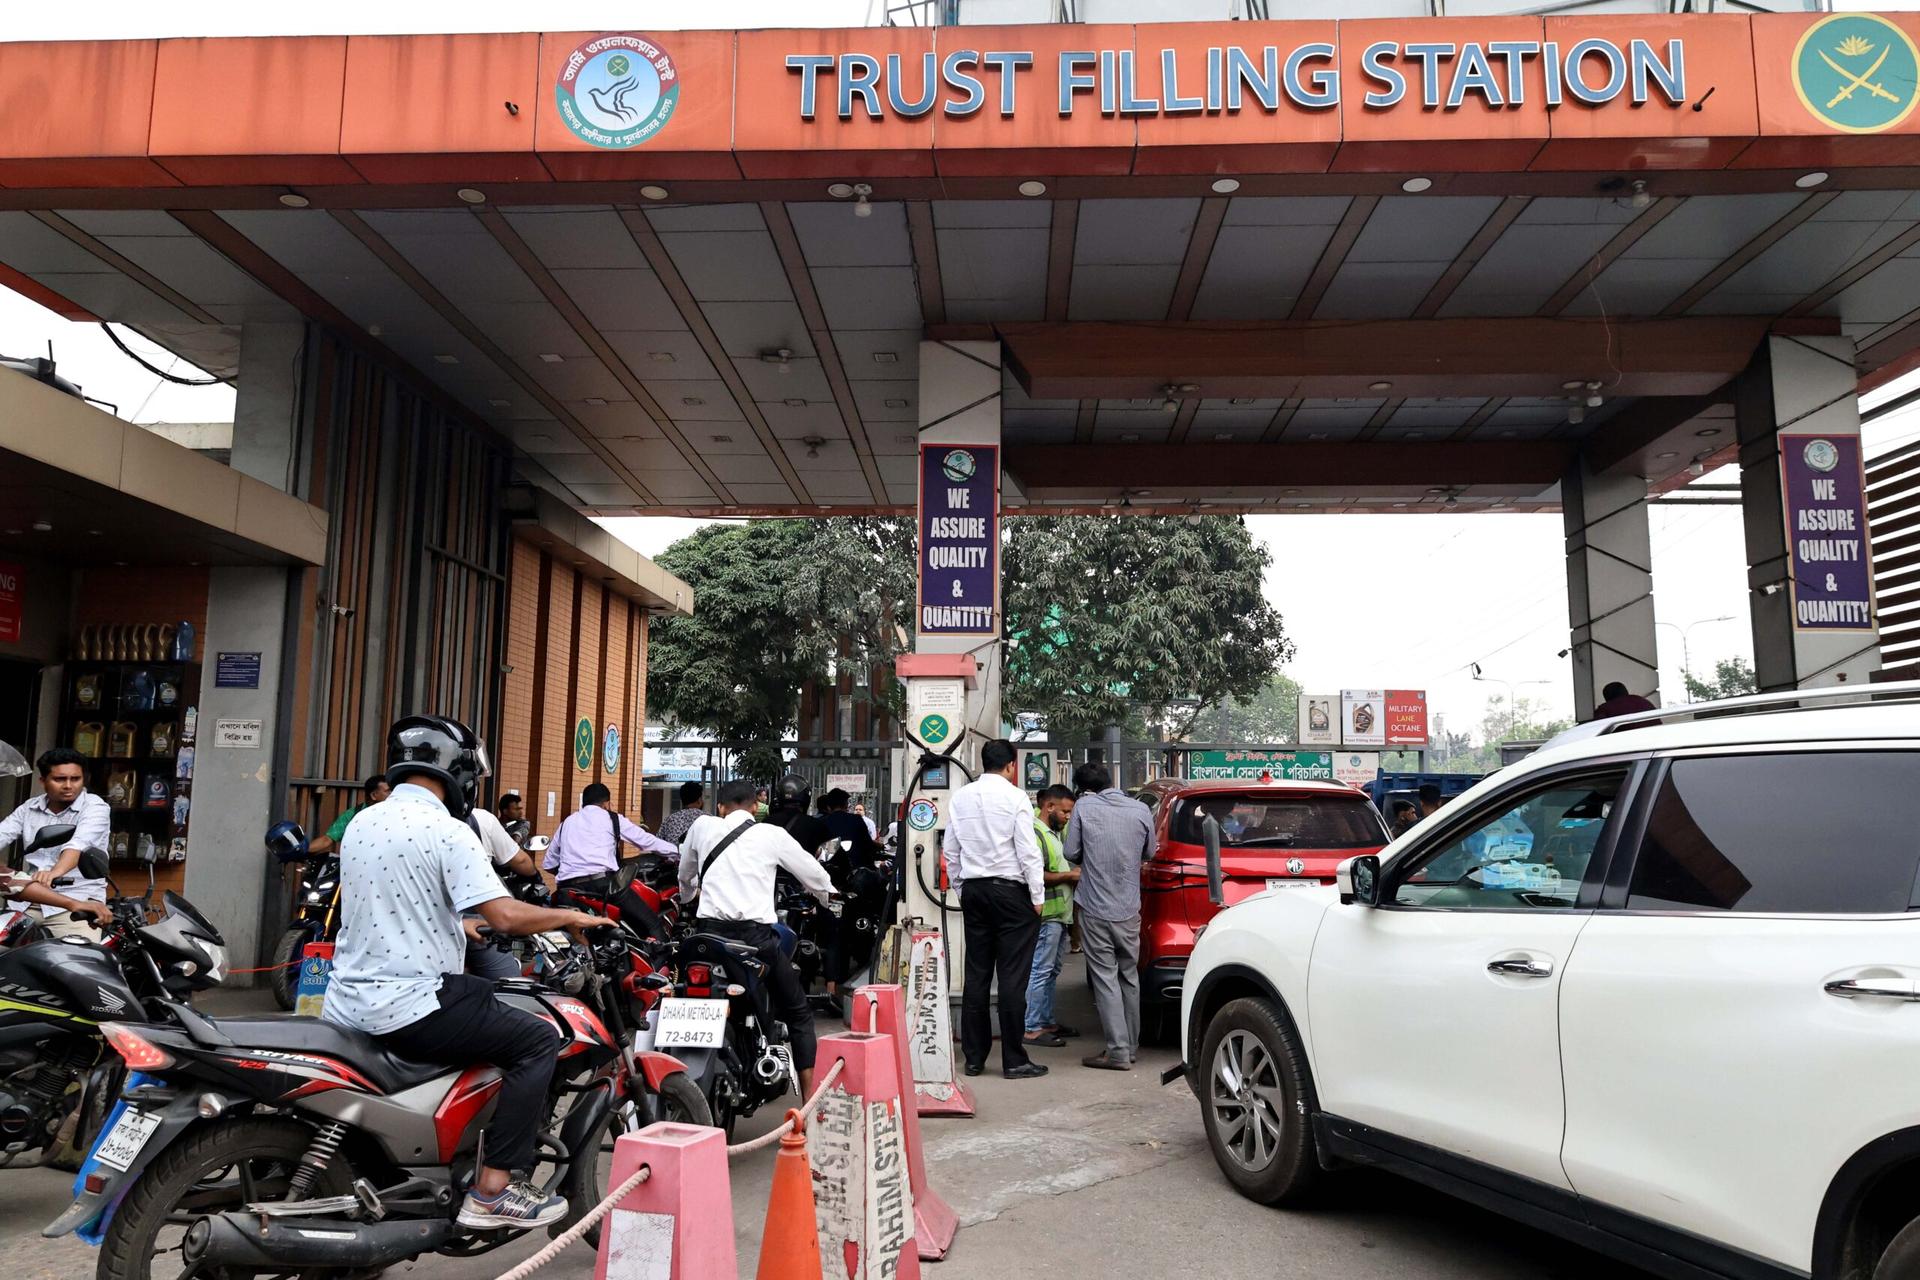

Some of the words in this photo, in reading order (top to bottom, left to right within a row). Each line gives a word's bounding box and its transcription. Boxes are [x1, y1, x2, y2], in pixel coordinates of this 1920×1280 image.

[586, 36, 659, 59] ওয়েলফেয়ার
[785, 50, 1033, 118] TRUST
[1058, 43, 1339, 115] FILLING
[1362, 38, 1686, 109] STATION
[947, 488, 970, 509] WE
[1811, 479, 1837, 501] WE
[930, 517, 986, 539] ASSURE
[1798, 509, 1856, 531] ASSURE
[929, 546, 987, 569] QUALITY
[1798, 539, 1859, 563] QUALITY
[952, 579, 963, 598] &
[1825, 573, 1838, 592] &
[922, 605, 992, 629] QUANTITY
[1797, 600, 1869, 624] QUANTITY
[1389, 704, 1423, 713] MILITARY
[1391, 724, 1422, 732] OCTANE
[1192, 765, 1234, 779] বাংলাদেশ
[1287, 762, 1331, 779] পরিচালিত
[91, 1005, 125, 1016] HONDA
[662, 1005, 687, 1020] DHAKA
[665, 1031, 714, 1043] 72-8473
[238, 1060, 268, 1070] 125
[871, 1101, 901, 1172] STEE
